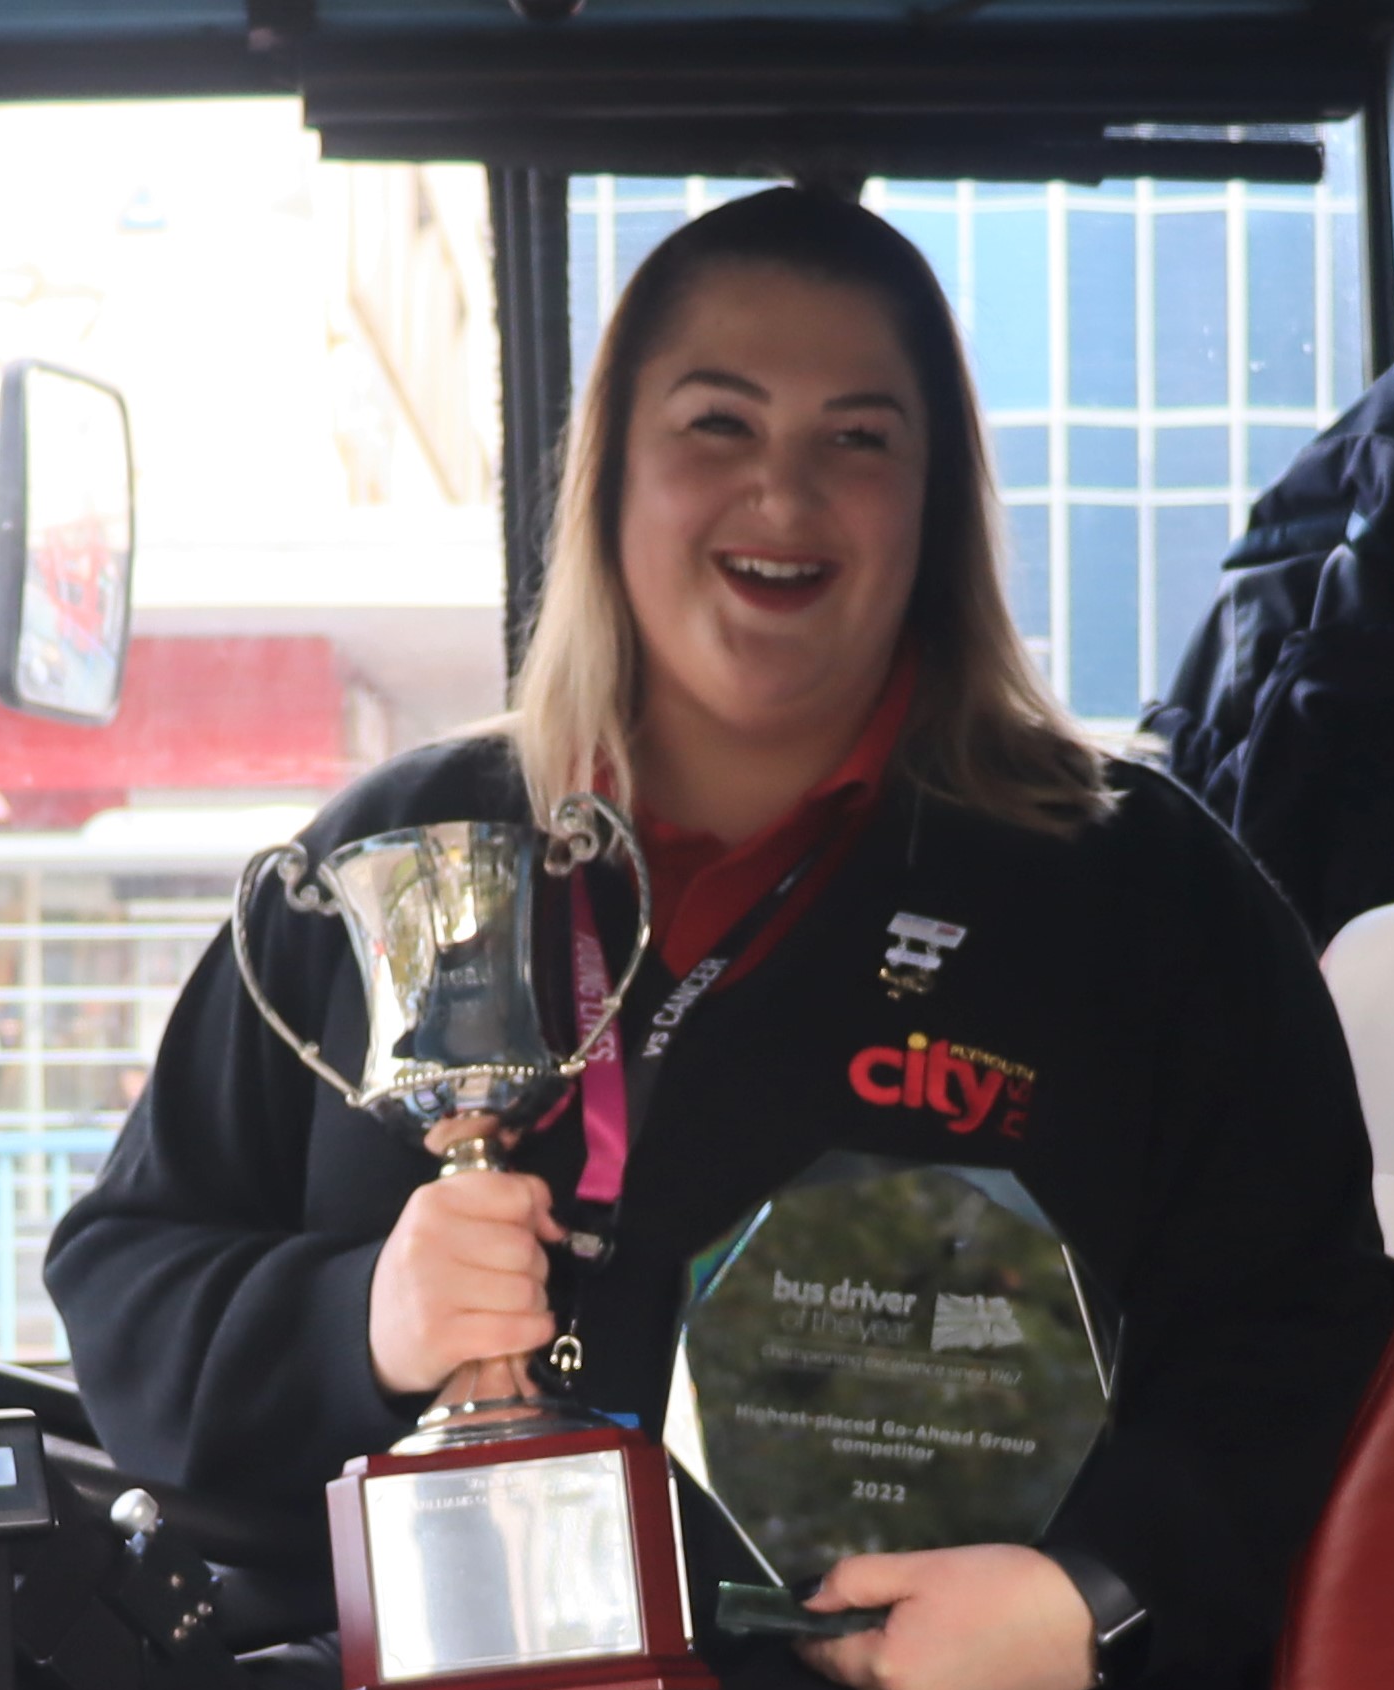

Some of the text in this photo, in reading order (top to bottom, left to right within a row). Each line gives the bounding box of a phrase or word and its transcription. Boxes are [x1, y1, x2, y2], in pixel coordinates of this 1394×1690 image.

[653, 957, 729, 1026] CANCER
[848, 1031, 1006, 1135] city
[949, 1043, 1038, 1082] PLYMOUTH
[773, 1269, 918, 1317] bus driver
[735, 1403, 1036, 1457] Highest-placed Go-Ahead Group
[832, 1436, 935, 1461] competitor
[852, 1480, 906, 1502] 2022
